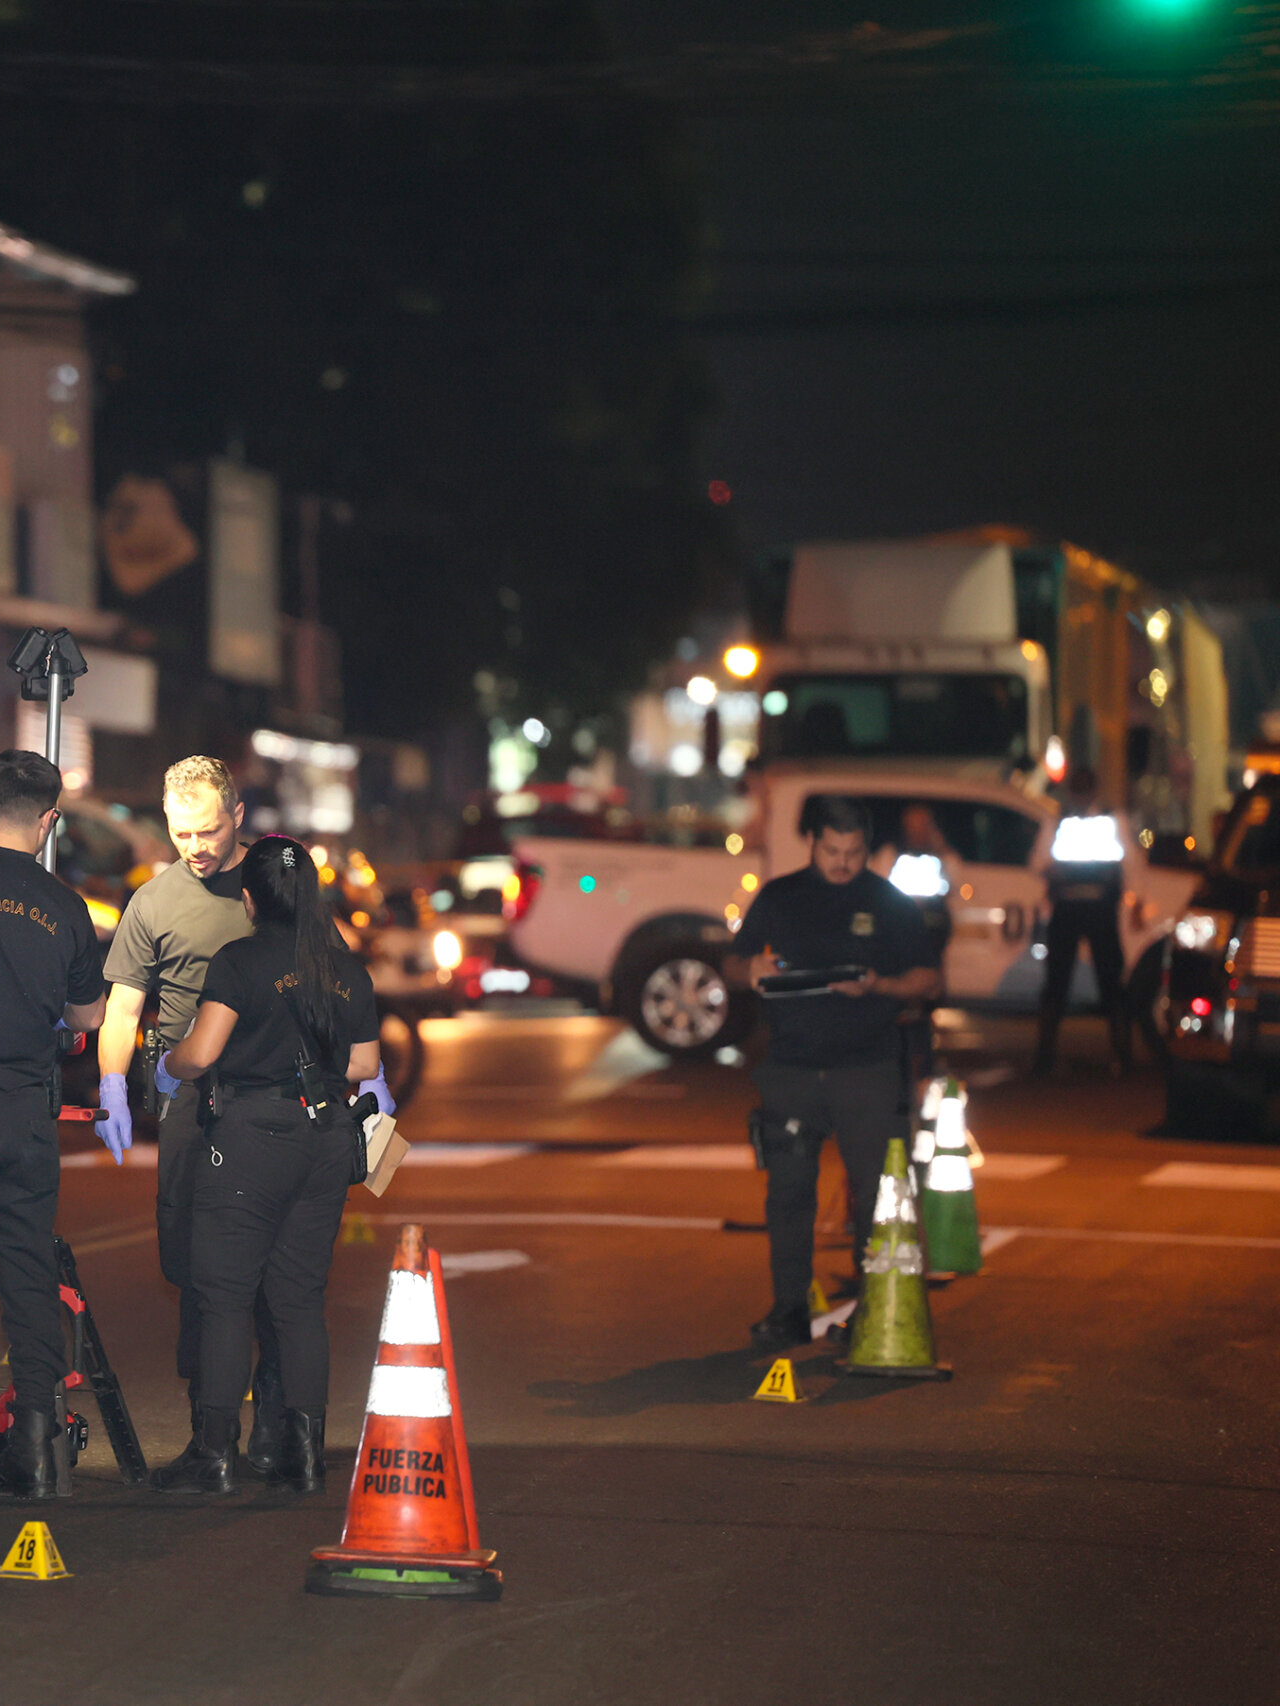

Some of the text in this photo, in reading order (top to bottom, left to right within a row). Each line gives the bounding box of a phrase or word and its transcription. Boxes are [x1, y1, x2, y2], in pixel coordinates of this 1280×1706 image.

[29, 907, 58, 936] O.I.J.
[770, 1371, 786, 1388] 11
[368, 1447, 445, 1474] FUERZA
[363, 1473, 447, 1499] PUBLICA
[18, 1538, 36, 1561] 18
